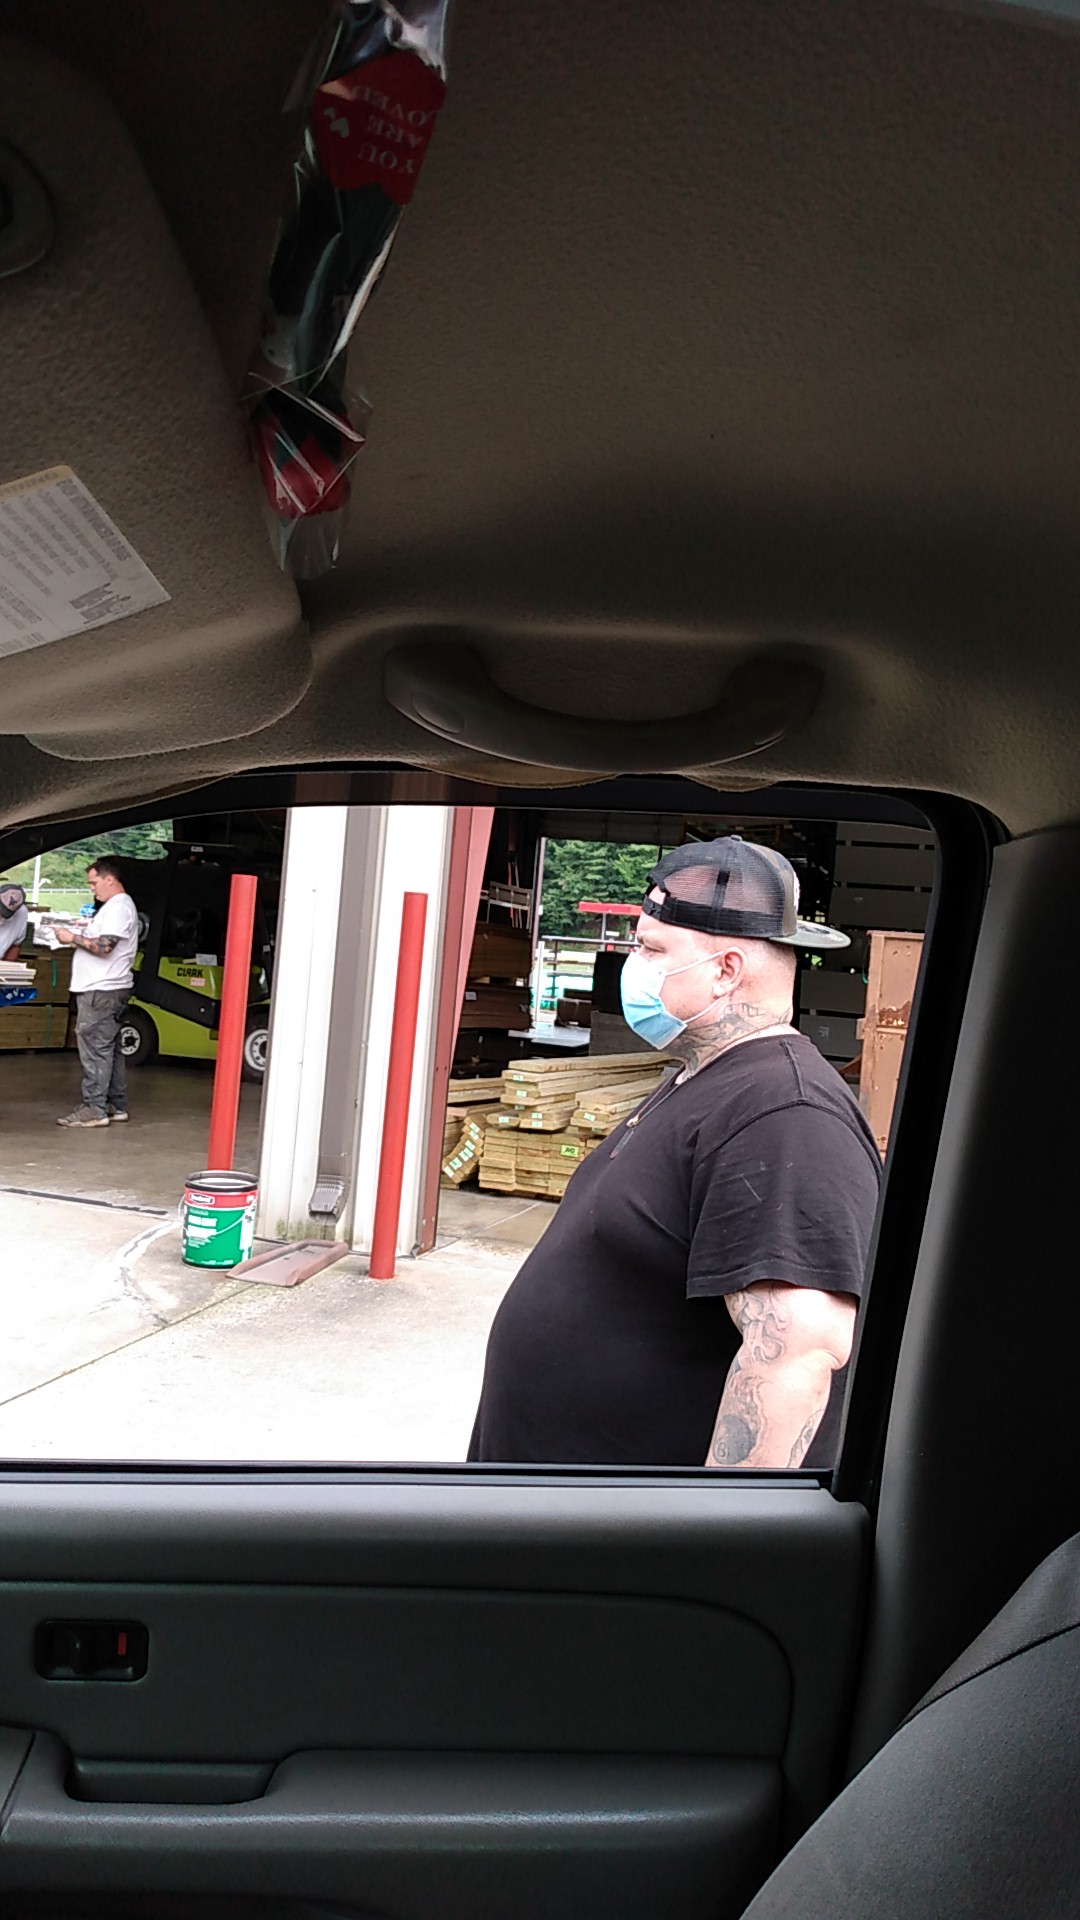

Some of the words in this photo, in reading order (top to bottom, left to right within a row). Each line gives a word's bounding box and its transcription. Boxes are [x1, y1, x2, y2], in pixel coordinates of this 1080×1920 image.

[367, 115, 424, 149] ARE
[357, 142, 414, 174] YOU
[176, 967, 204, 978] CLARK
